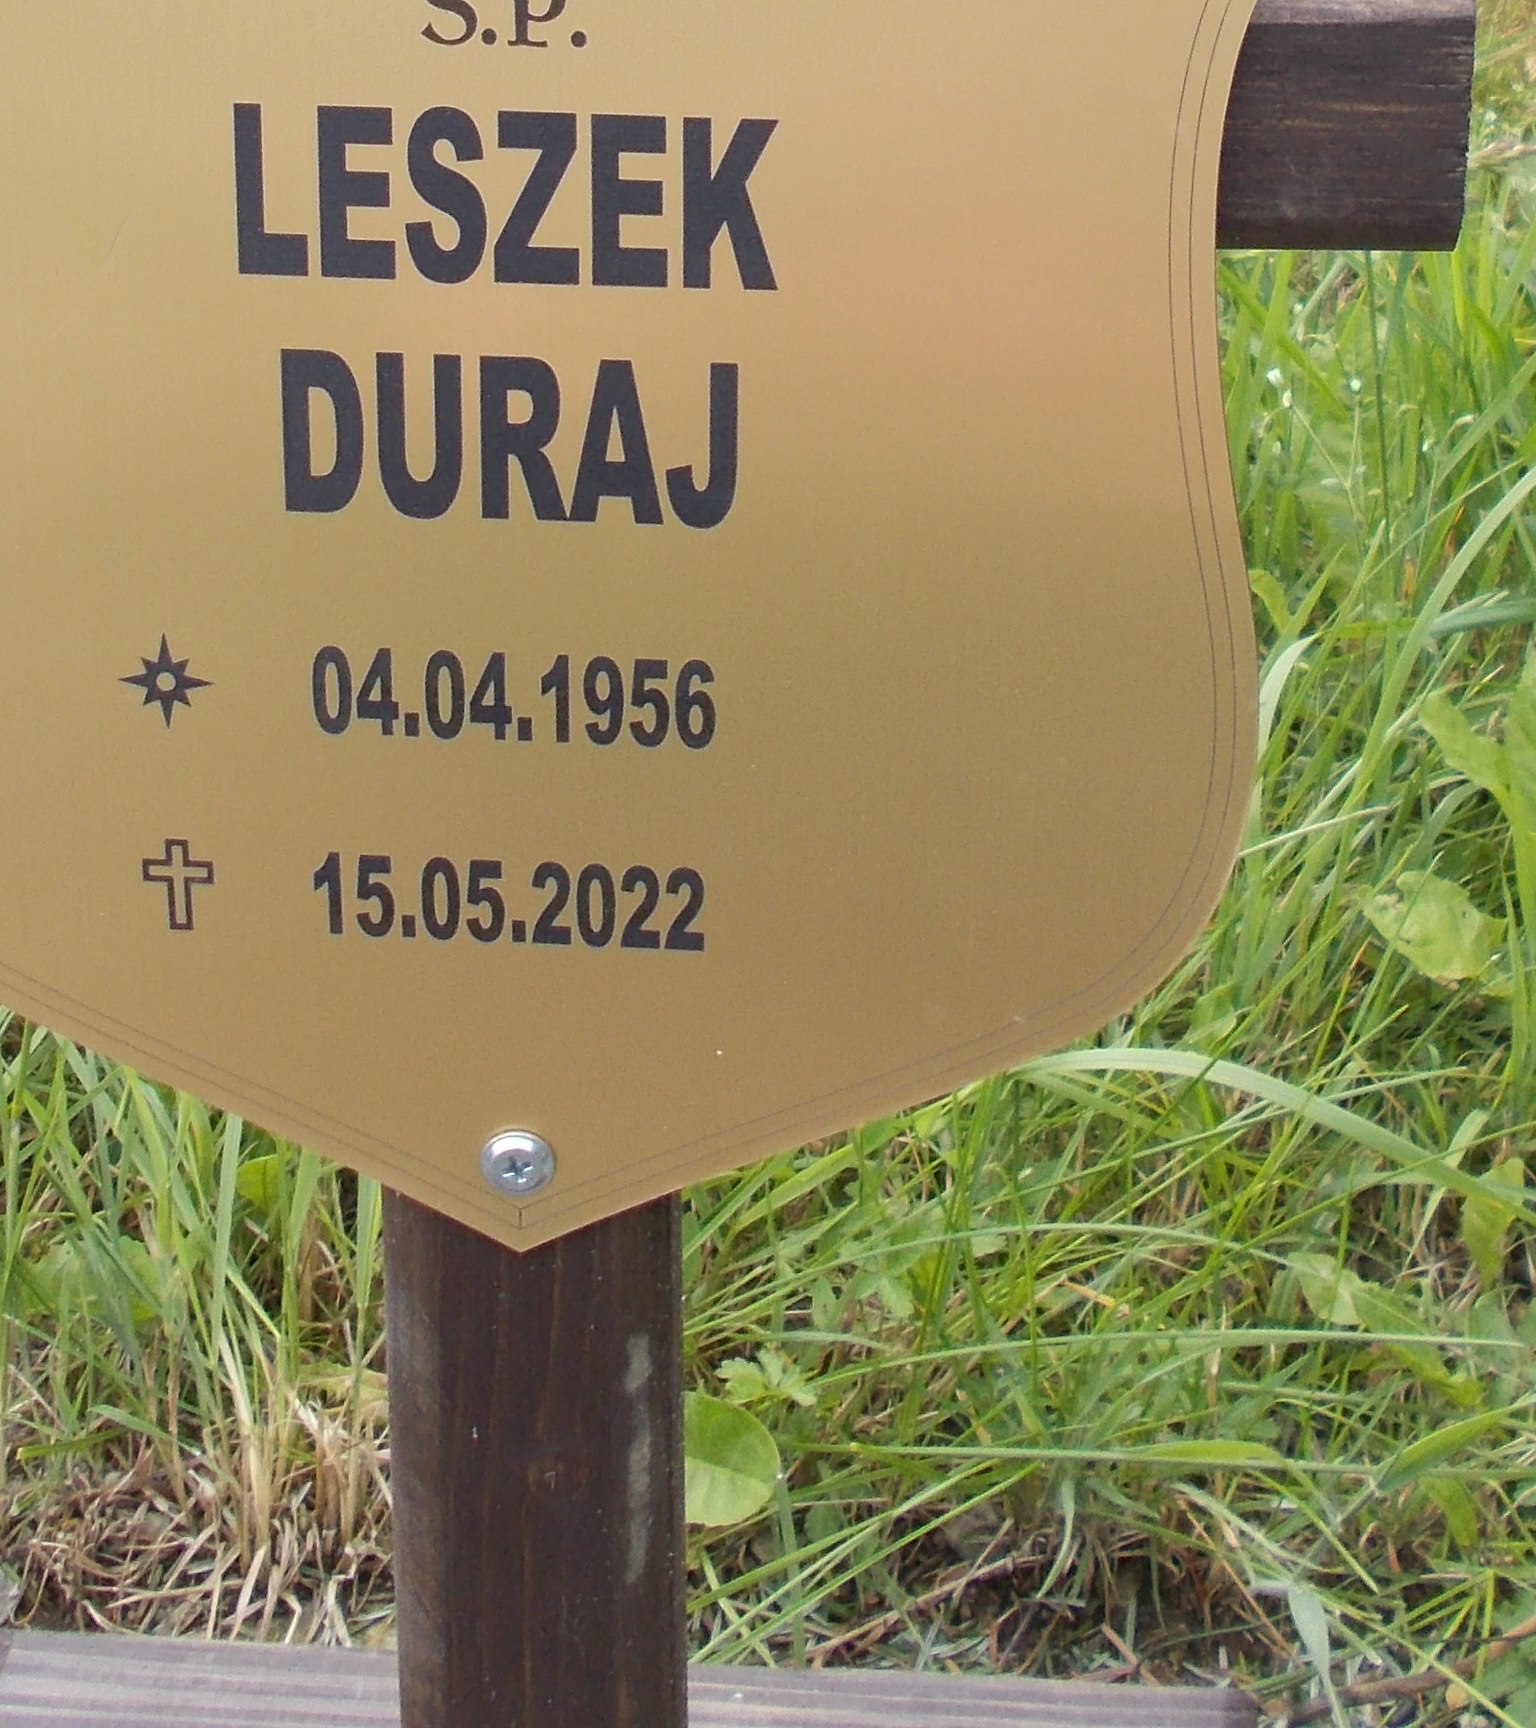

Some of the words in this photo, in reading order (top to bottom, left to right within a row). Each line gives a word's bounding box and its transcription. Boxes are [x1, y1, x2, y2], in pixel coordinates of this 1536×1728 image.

[232, 102, 780, 291] LESZEK
[279, 347, 740, 529] DURAJ
[311, 645, 717, 750] 04.04.1956
[312, 850, 706, 952] 15.05.2022
